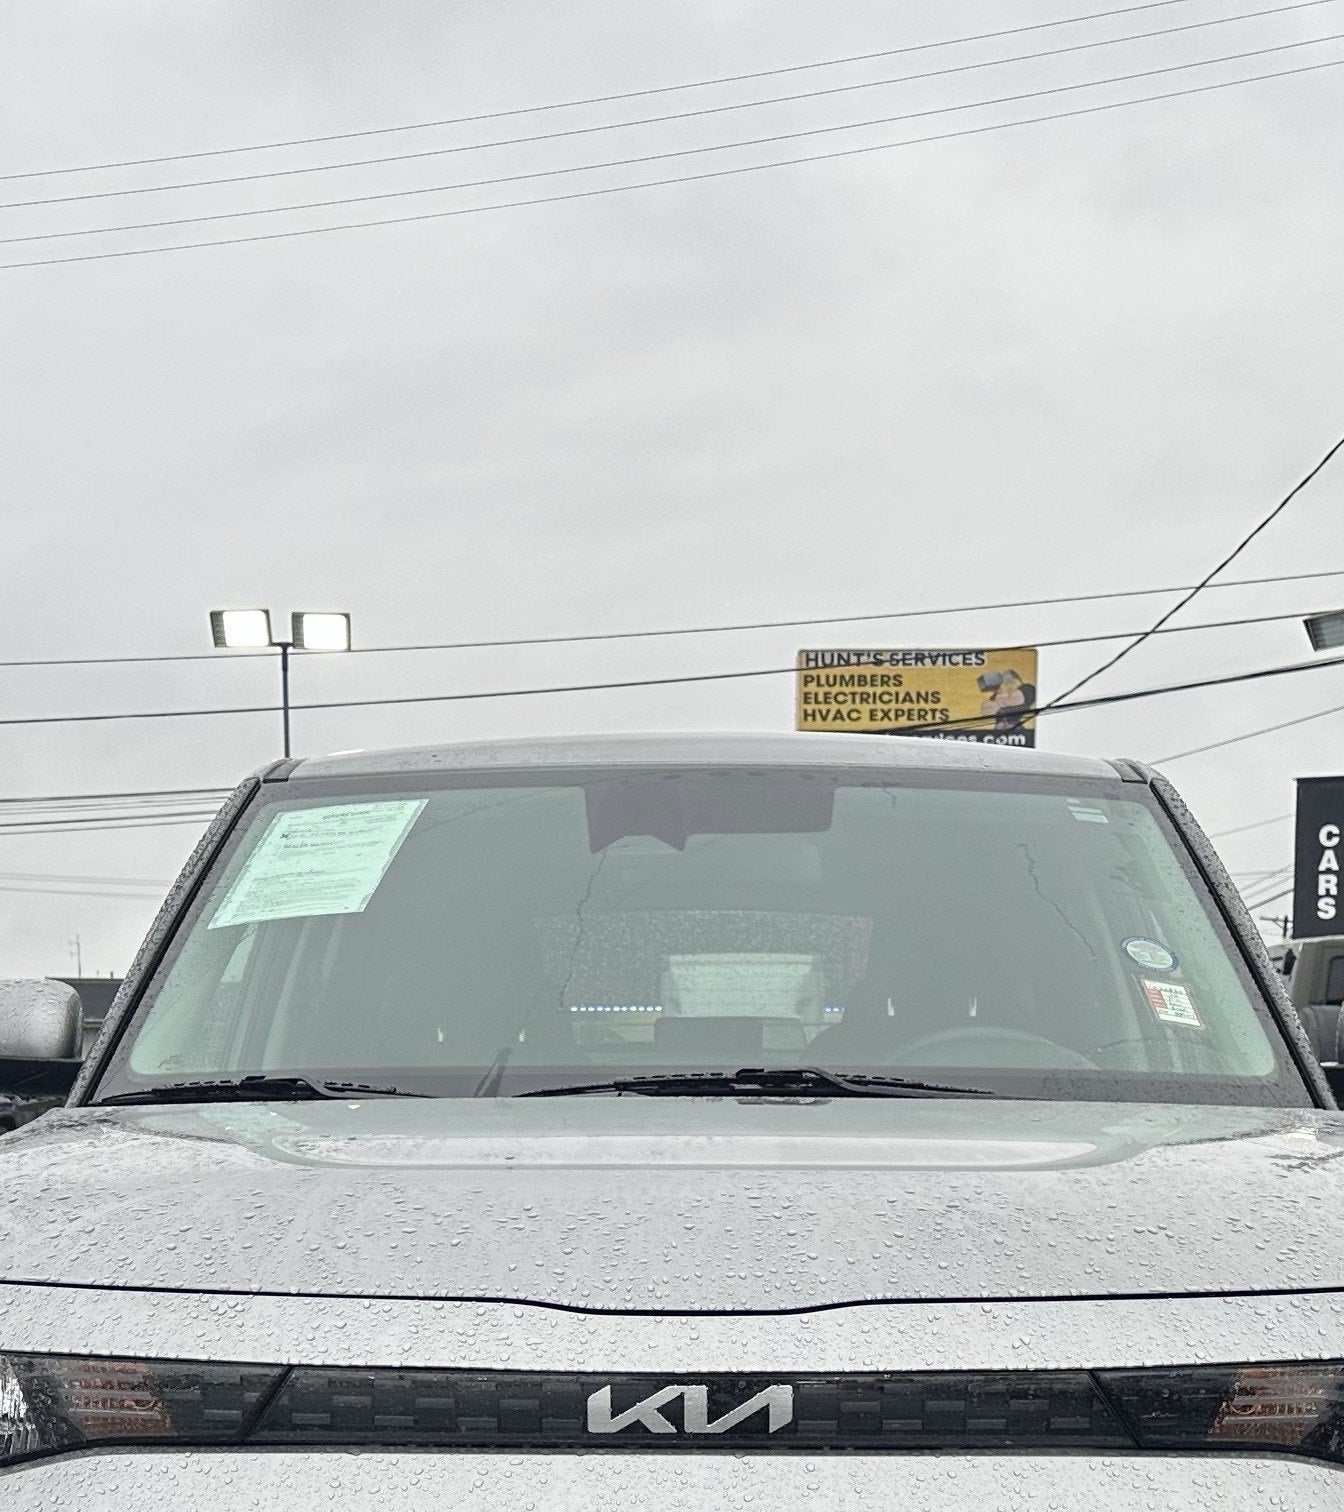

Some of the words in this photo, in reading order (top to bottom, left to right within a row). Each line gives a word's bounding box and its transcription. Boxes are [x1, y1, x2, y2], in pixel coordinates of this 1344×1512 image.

[805, 652, 884, 668] HUNT'S
[889, 651, 985, 666] SERVICES
[803, 674, 904, 687] PLUMBERS
[803, 691, 941, 705] ELECTRICIANS
[803, 708, 862, 721] HVAC
[869, 708, 949, 722] EXPERTS
[1316, 823, 1341, 920] CARS
